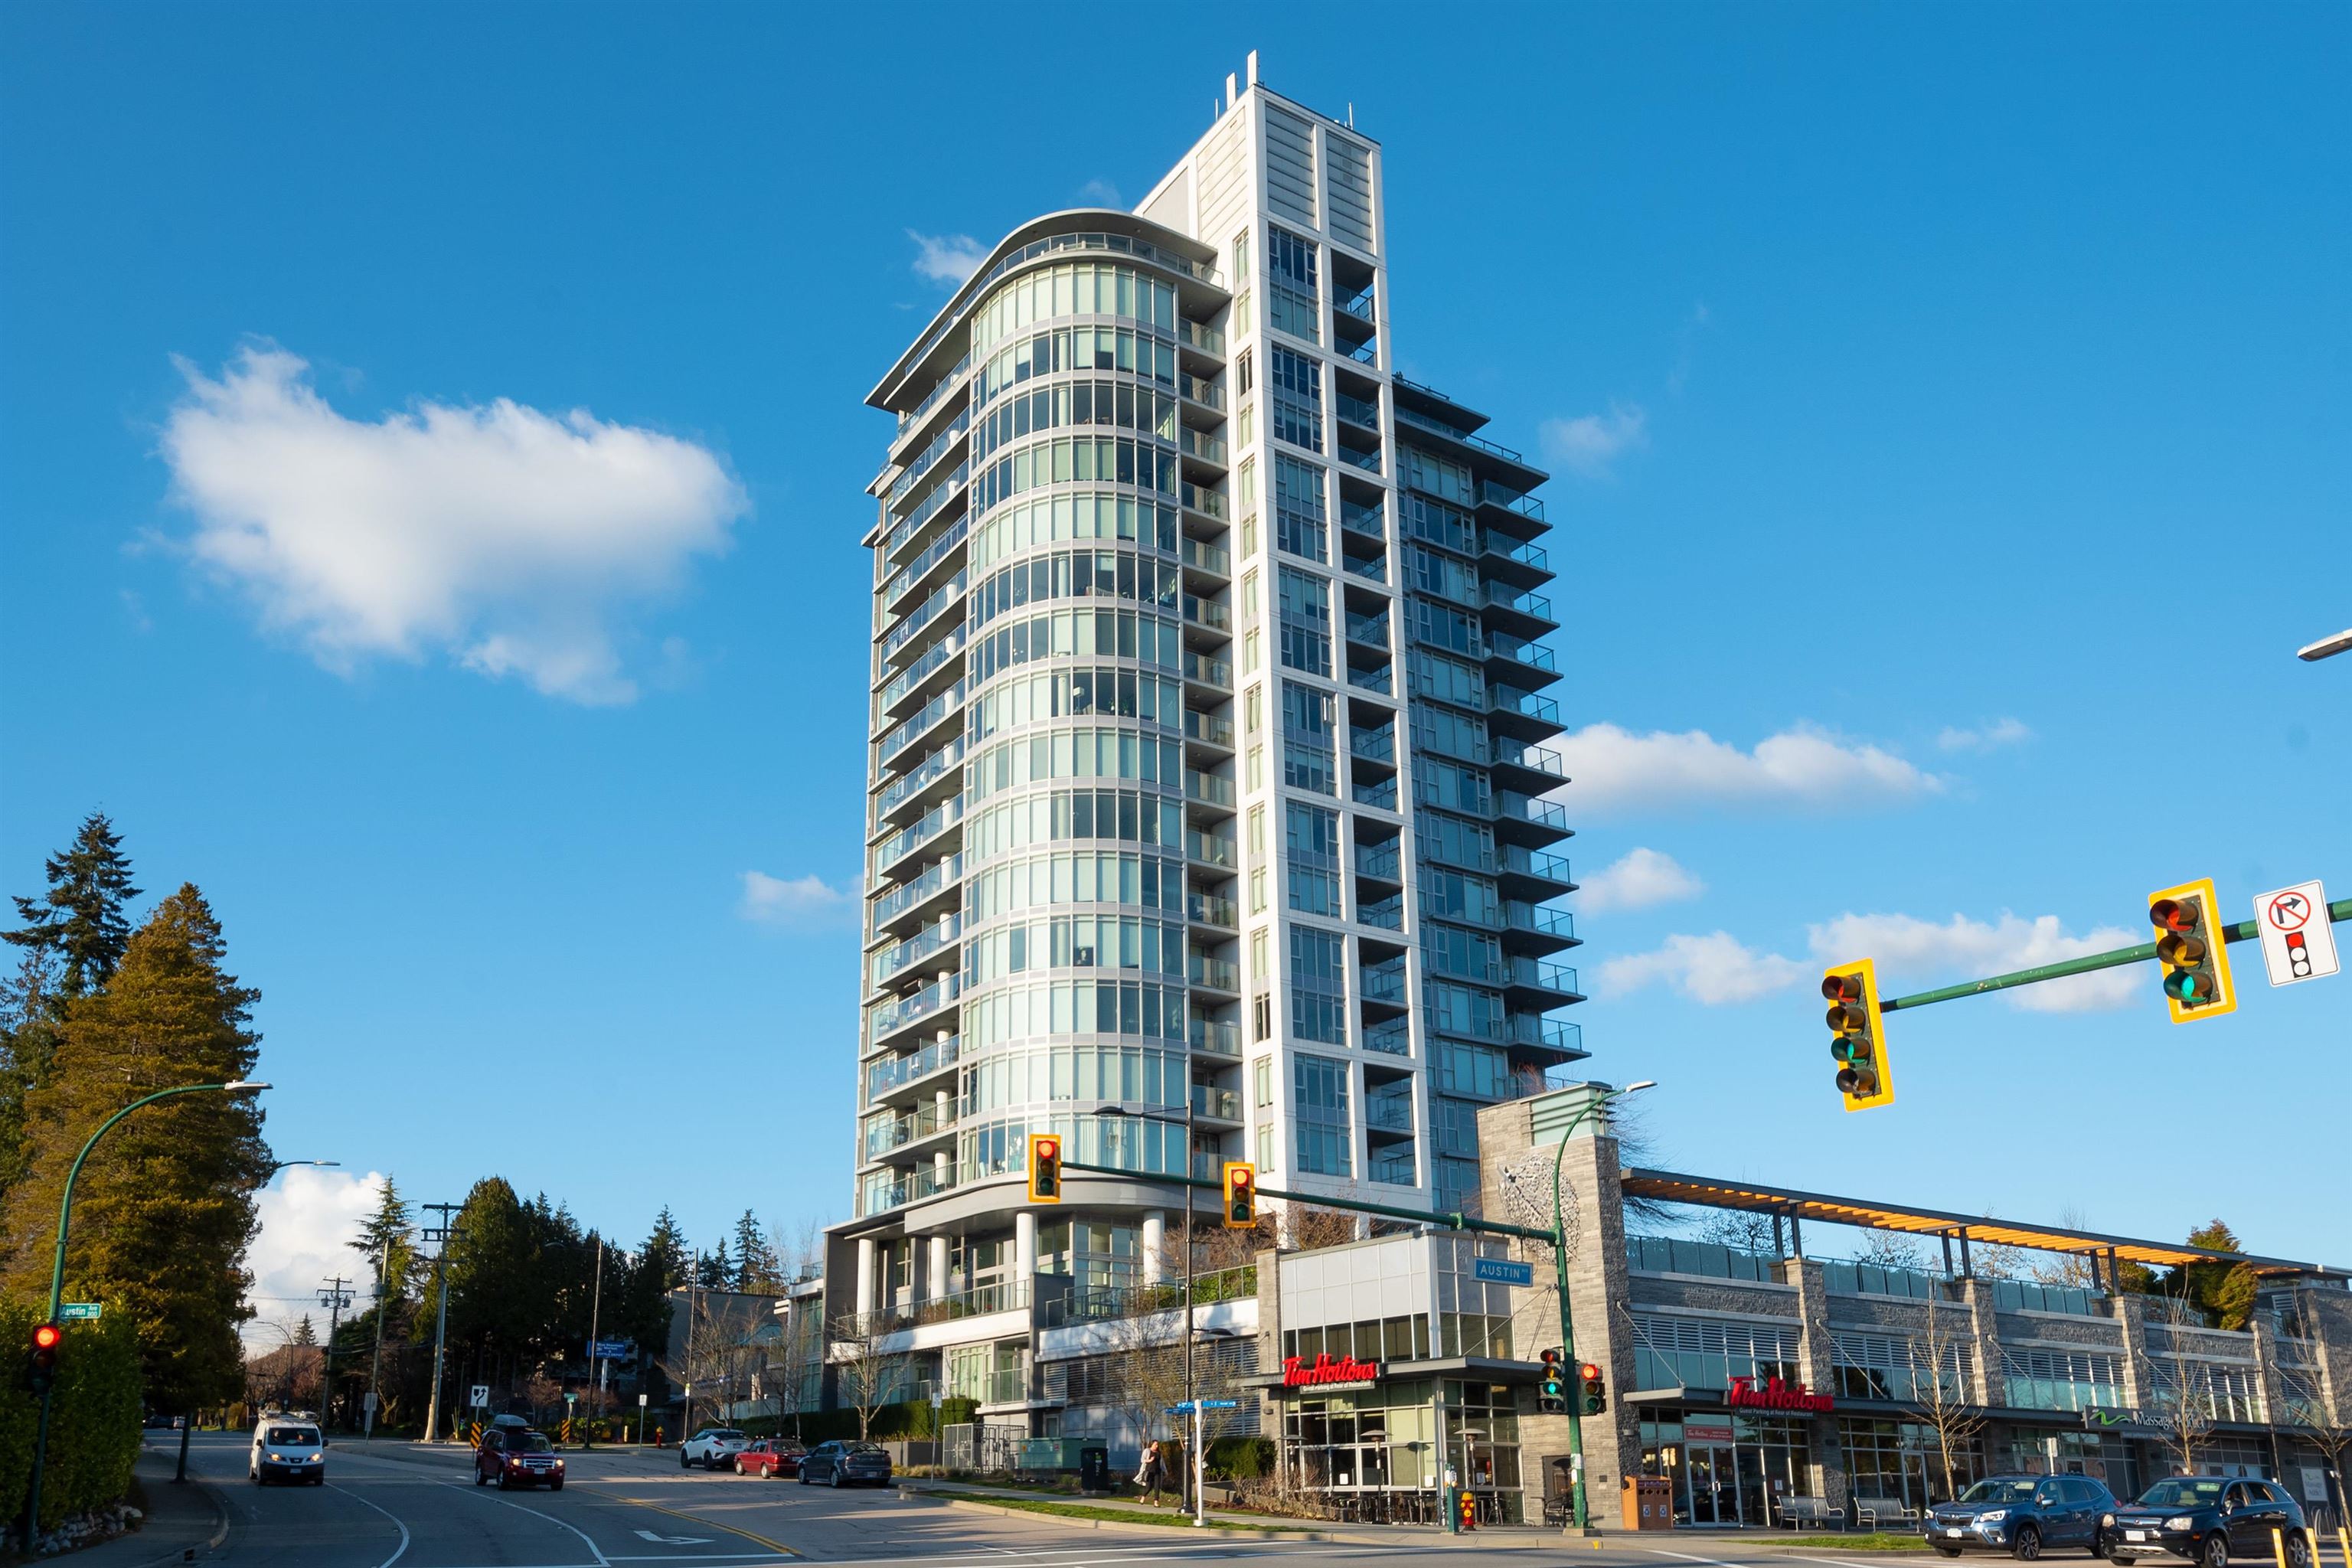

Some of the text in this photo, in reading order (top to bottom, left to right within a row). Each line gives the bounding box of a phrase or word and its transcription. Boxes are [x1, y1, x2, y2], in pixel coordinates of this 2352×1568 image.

[1480, 1264, 1520, 1279] AUSTIN
[61, 1306, 86, 1316] Austin
[1282, 1353, 1376, 1387] Tim Hortons
[1729, 1376, 1833, 1410] Tim Hortons
[2132, 1410, 2173, 1430] Massage
